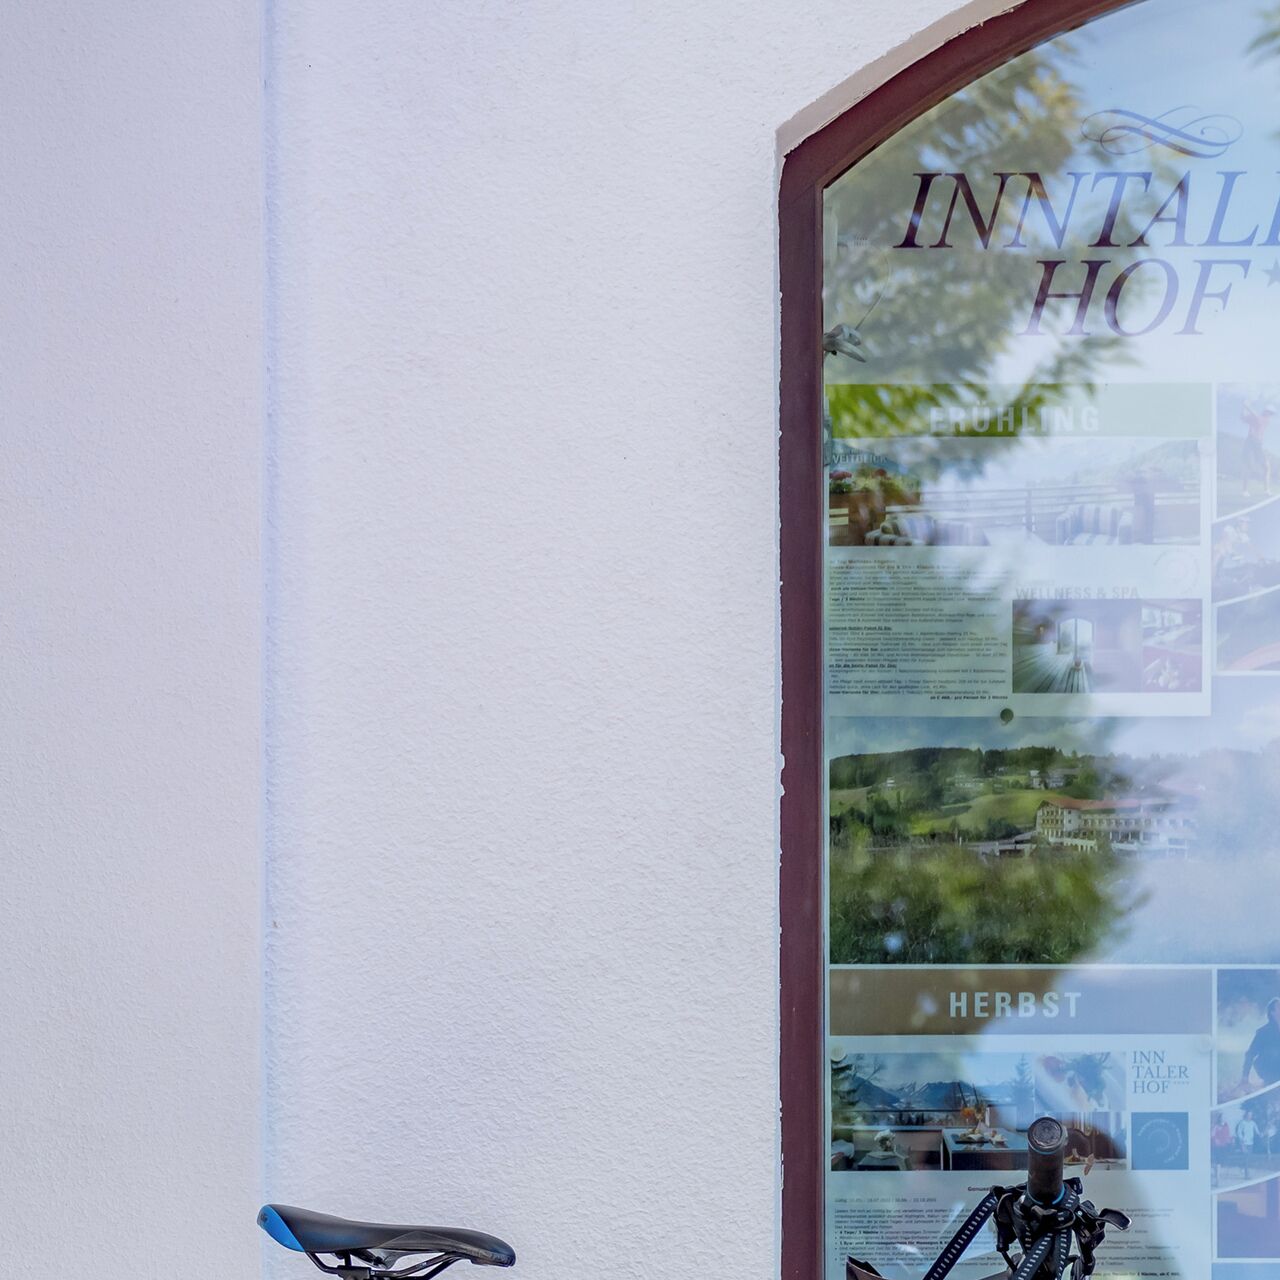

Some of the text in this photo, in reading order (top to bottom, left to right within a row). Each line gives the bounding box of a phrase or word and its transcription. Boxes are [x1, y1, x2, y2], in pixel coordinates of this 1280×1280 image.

[1017, 257, 1253, 338] HOF
[1016, 585, 1091, 600] WELLNESS
[1112, 585, 1140, 600] SPA
[949, 991, 1082, 1019] HERBST
[1132, 1050, 1165, 1065] INN
[1132, 1064, 1190, 1079] TALER
[1132, 1080, 1169, 1094] HOF
